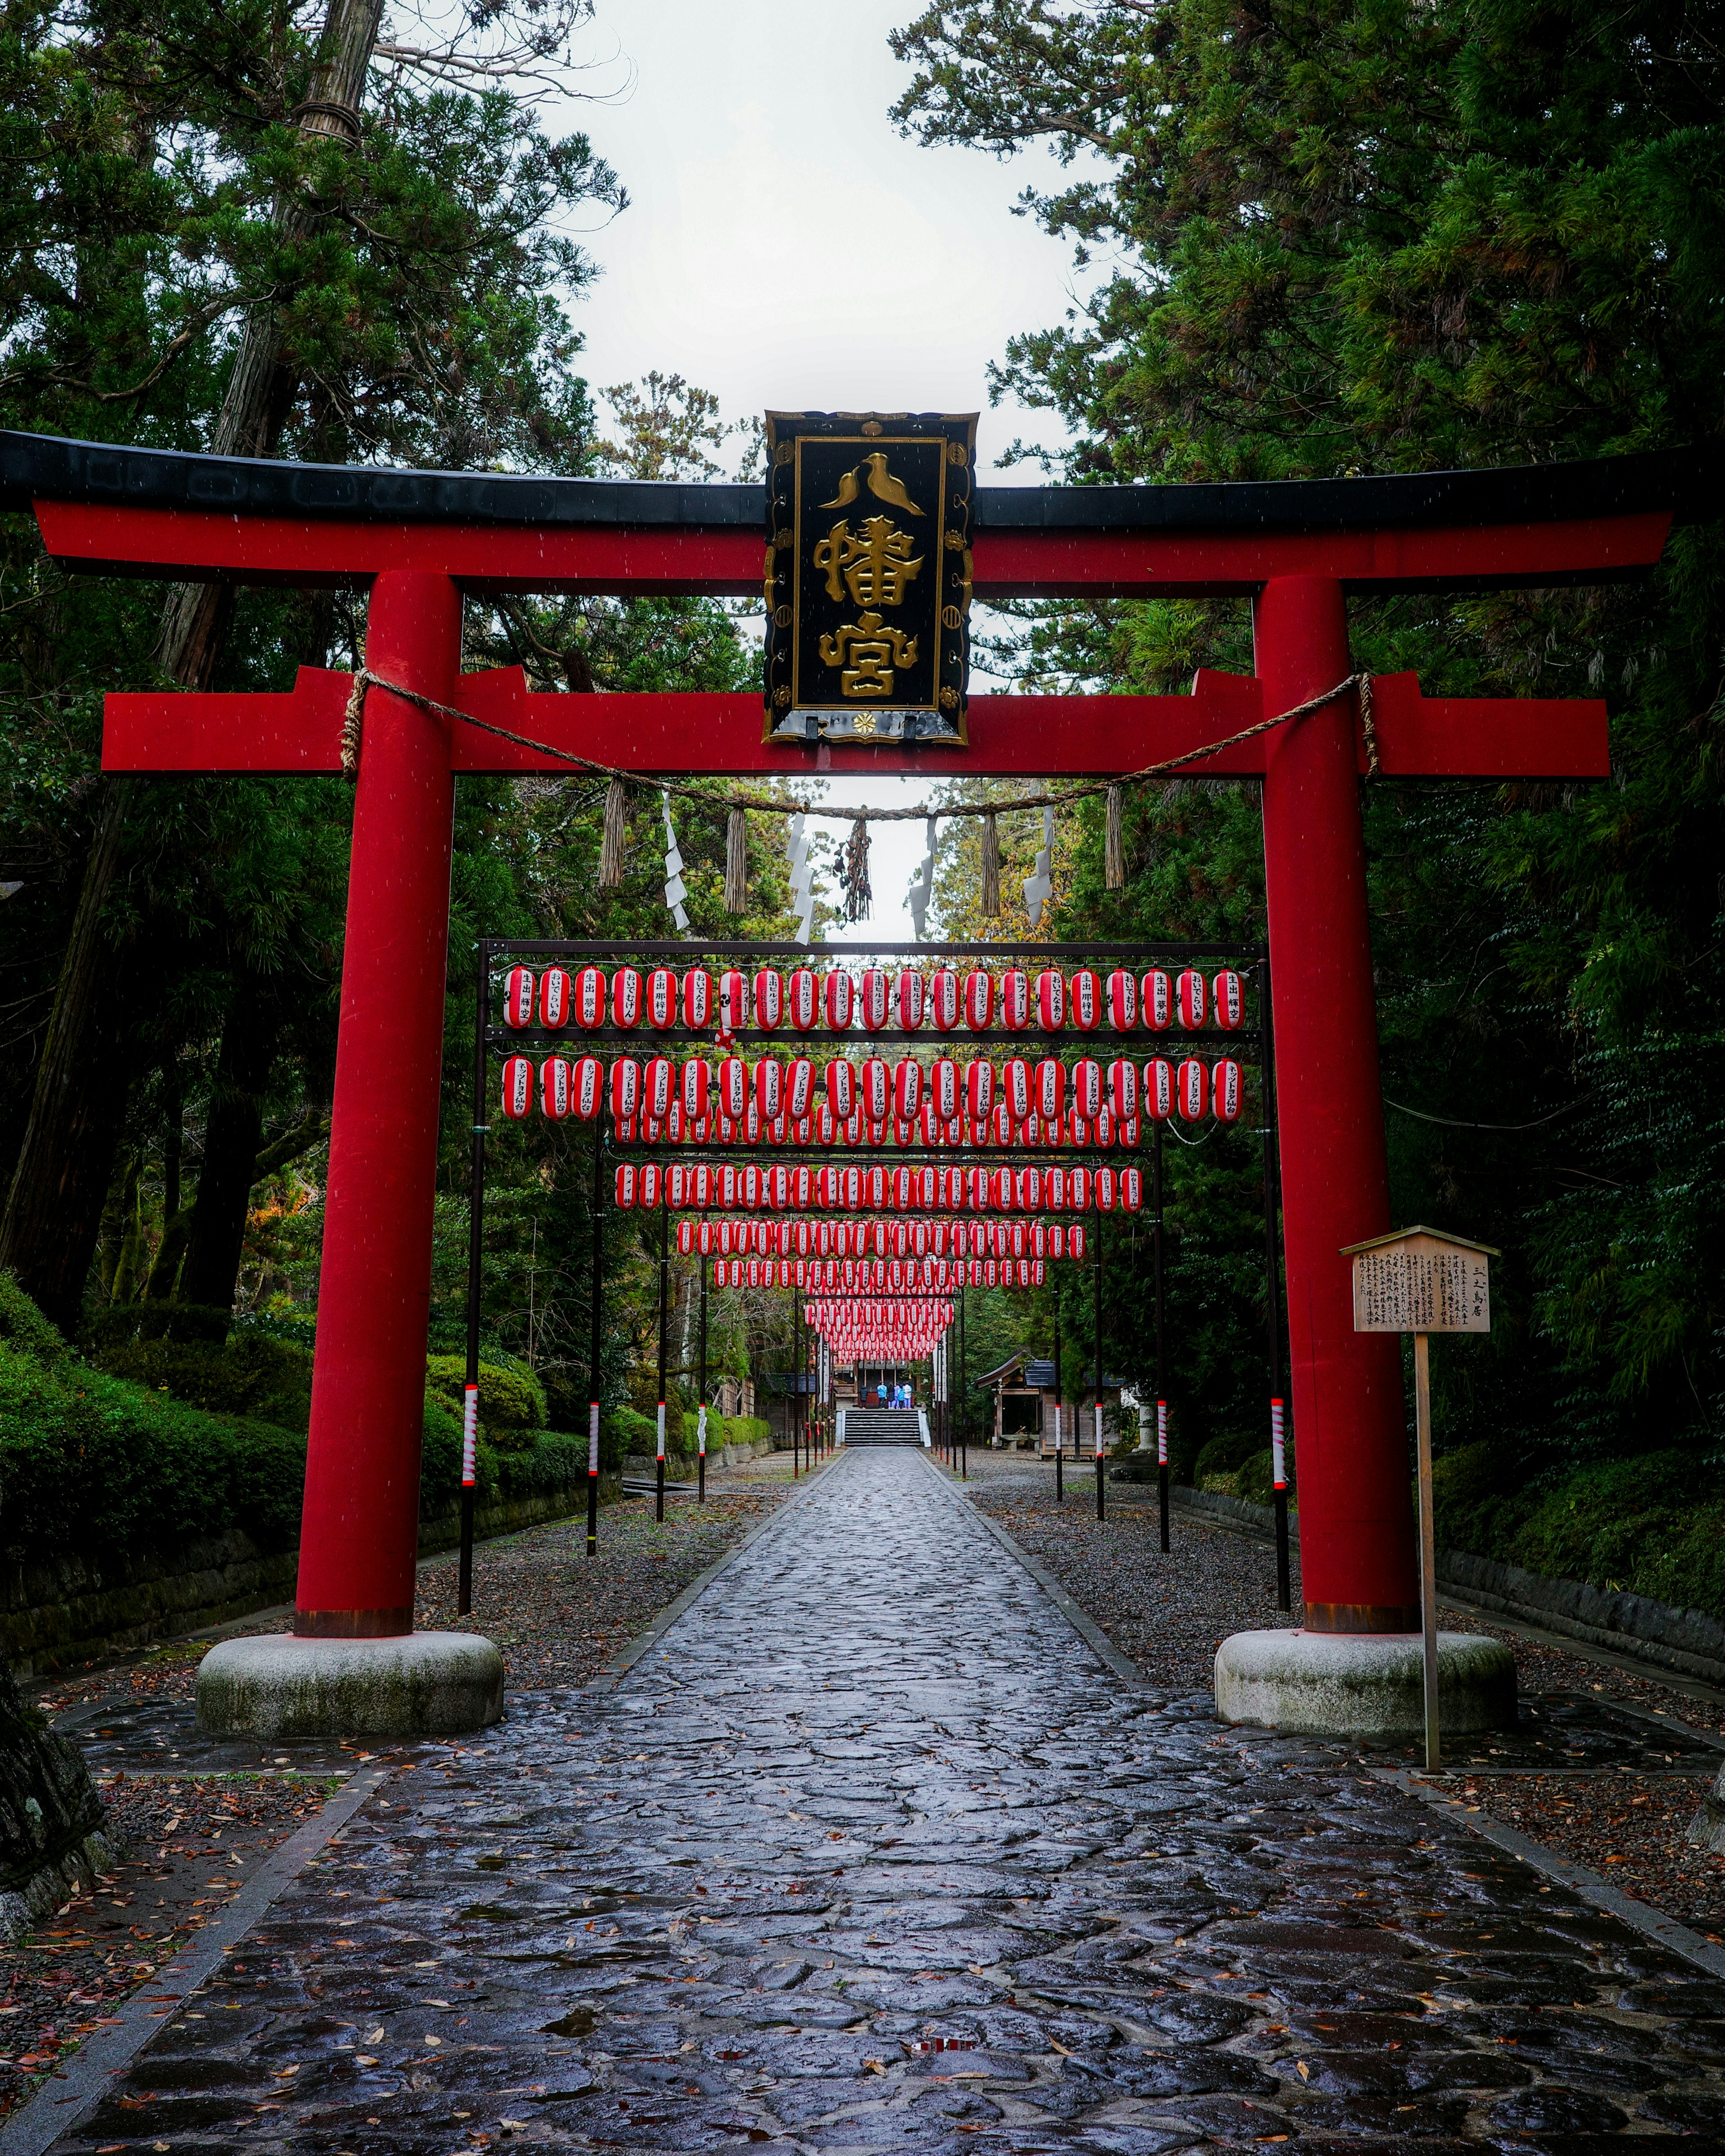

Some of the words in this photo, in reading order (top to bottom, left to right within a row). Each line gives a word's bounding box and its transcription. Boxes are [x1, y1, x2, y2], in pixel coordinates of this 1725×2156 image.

[814, 452, 926, 697] 八幡宮
[522, 972, 532, 993] 生出
[550, 973, 560, 1018] おいでらいあ
[585, 974, 594, 993] 生出
[625, 974, 635, 1018] おいでむげん
[656, 974, 665, 989] 生出
[696, 975, 705, 1019] おいでなあら
[769, 973, 778, 1021] 生出ビルディング
[802, 975, 812, 1019] 生出ビルディング
[838, 975, 848, 1021] 生出ビルディング
[875, 975, 883, 1021] 生出ビルディング
[913, 975, 922, 1020] 生出ビルディング
[946, 974, 955, 1021] 生出ビルディング
[978, 975, 987, 1021] 生出ビルディング
[1053, 975, 1062, 1021] おいでなあら
[1082, 975, 1091, 990] 生出
[1157, 976, 1167, 995] 生出
[1192, 975, 1202, 1021] おいでらいあ
[1229, 975, 1238, 994] 生出
[520, 997, 531, 1020] 輝空
[584, 998, 595, 1018] 夢弦
[655, 993, 665, 1018] 那梓愛
[1082, 994, 1092, 1020] 那梓愛
[1157, 1000, 1167, 1021] 夢弦
[1229, 998, 1239, 1019] 輝空
[515, 1063, 526, 1111] ネッツトヨタ仙台
[557, 1063, 566, 1112] ネッツトヨタ仙台
[582, 1064, 594, 1112] ネッツトヨタ仙台
[624, 1065, 635, 1113] ネッツトヨタ仙台
[656, 1065, 667, 1112] ネッツトヨタ仙台
[686, 1065, 696, 1113] ネッツトヨタ仙台
[733, 1064, 742, 1111] ネッツトヨタ仙台
[769, 1066, 778, 1114] ネッツトヨタ仙台
[795, 1065, 809, 1113] ネッツトヨタ仙台
[838, 1065, 849, 1112] ネッツトヨタ仙台
[875, 1065, 885, 1114] ネッツトヨタ仙台
[906, 1065, 918, 1114] ネッツトヨタ仙台
[944, 1066, 954, 1114] ネッツトヨタ仙台
[980, 1066, 990, 1114] ネッツトヨタ仙台
[1015, 1065, 1026, 1113] ネッツトヨタ仙台
[1044, 1065, 1054, 1114] ネッツトヨタ仙台
[1089, 1064, 1098, 1113] ネッツトヨタ仙台
[1125, 1065, 1135, 1114] ネッツトヨタ仙台
[1159, 1064, 1169, 1112] ネッツトヨタ仙台
[1190, 1064, 1200, 1113] ネッツトヨタ仙台
[1227, 1064, 1237, 1114] ネッツトヨタ仙台
[1472, 1267, 1484, 1317] 三之鳥居
